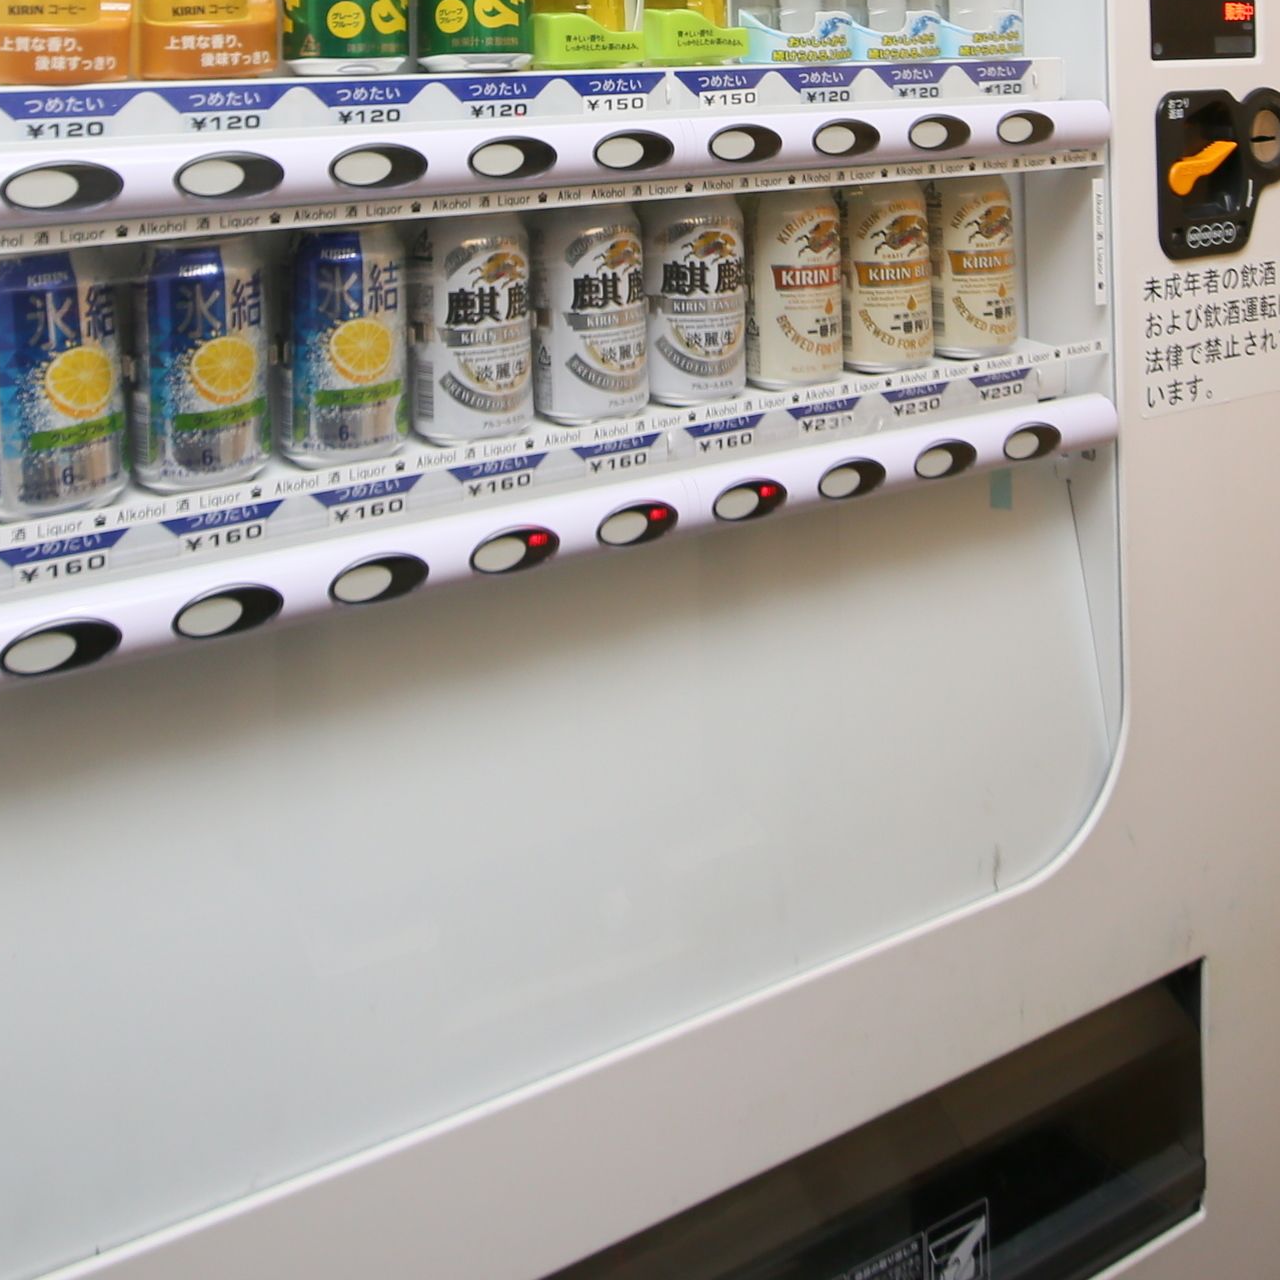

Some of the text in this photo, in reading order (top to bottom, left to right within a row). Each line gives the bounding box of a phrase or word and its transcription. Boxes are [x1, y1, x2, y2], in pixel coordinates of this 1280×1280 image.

[8, 3, 86, 16] KIRIN コーヒー
[171, 3, 240, 17] KIRIN コーヒー
[34, 55, 118, 72] 後味すっきり
[977, 65, 1017, 77] つめたい
[698, 74, 747, 87] つめたい
[799, 71, 844, 84] つめたい
[891, 67, 934, 80] つめたい
[336, 85, 401, 101] つめたい
[469, 81, 527, 96] つめたい
[589, 78, 642, 92] つめたい
[898, 87, 939, 98] ¥120
[24, 95, 104, 113] つめたい
[189, 91, 261, 107] つめたい
[586, 98, 644, 110] ¥150
[703, 92, 756, 106] ¥150
[807, 90, 850, 103] ¥120
[338, 109, 401, 124] ¥120
[471, 104, 527, 118] ¥120
[27, 122, 104, 138] ¥120
[191, 115, 261, 130] ¥120
[34, 231, 49, 246] 酒
[60, 228, 105, 243] Liquor
[138, 220, 186, 235] Alkohol
[196, 217, 210, 230] 酒
[220, 215, 260, 230] Liquor
[293, 207, 336, 222] Alkohol
[345, 205, 357, 217] 酒
[365, 203, 402, 217] Liquor
[432, 197, 471, 211] Alkohol
[479, 196, 490, 208] 酒
[497, 194, 530, 208] Liquor
[591, 187, 626, 199] Alkohol
[632, 185, 642, 197] 酒
[648, 183, 678, 196] Liquor
[702, 179, 734, 191] Alkohol
[740, 177, 749, 188] 酒
[754, 176, 782, 188] Liquor
[962, 255, 1001, 269] KIRIN
[27, 271, 68, 287] KIRIN
[179, 264, 218, 278] KIRIN
[661, 260, 745, 294] 麒麟
[781, 269, 829, 286] KIRIN
[869, 267, 912, 281] KIRIN
[318, 261, 400, 313] 氷結
[1143, 260, 1276, 303] 未成年者の飲酒
[176, 272, 264, 338] 氷結
[673, 300, 706, 312] KIRIN
[951, 295, 988, 331] BREWED
[27, 283, 117, 350] 氷結
[586, 315, 619, 328] KIRIN
[776, 314, 815, 352] BREWED
[858, 308, 916, 350] BREWED FOR
[461, 331, 497, 344] KIRIN
[980, 383, 1023, 400] ¥230
[1147, 374, 1213, 409] います。
[893, 398, 940, 416] ¥230
[699, 432, 752, 452] ¥160
[37, 519, 82, 538] Liquor
[117, 505, 165, 524] Alkohol
[199, 491, 241, 508] Liquor
[275, 478, 319, 495] Alkohol
[349, 465, 386, 481] Liquor
[416, 452, 457, 468] Alkohol
[483, 442, 517, 458] Liquor
[544, 430, 581, 447] Alkohol
[594, 424, 629, 440] Alkohol
[651, 415, 681, 430] Liquor
[705, 405, 738, 420] Alkohol
[758, 396, 786, 410] Liquor
[590, 453, 647, 473] ¥160
[468, 473, 531, 497] ¥160
[335, 499, 403, 523] ¥160
[186, 524, 262, 550] ¥160
[24, 534, 102, 558] つめたい
[22, 555, 106, 583] ¥160
